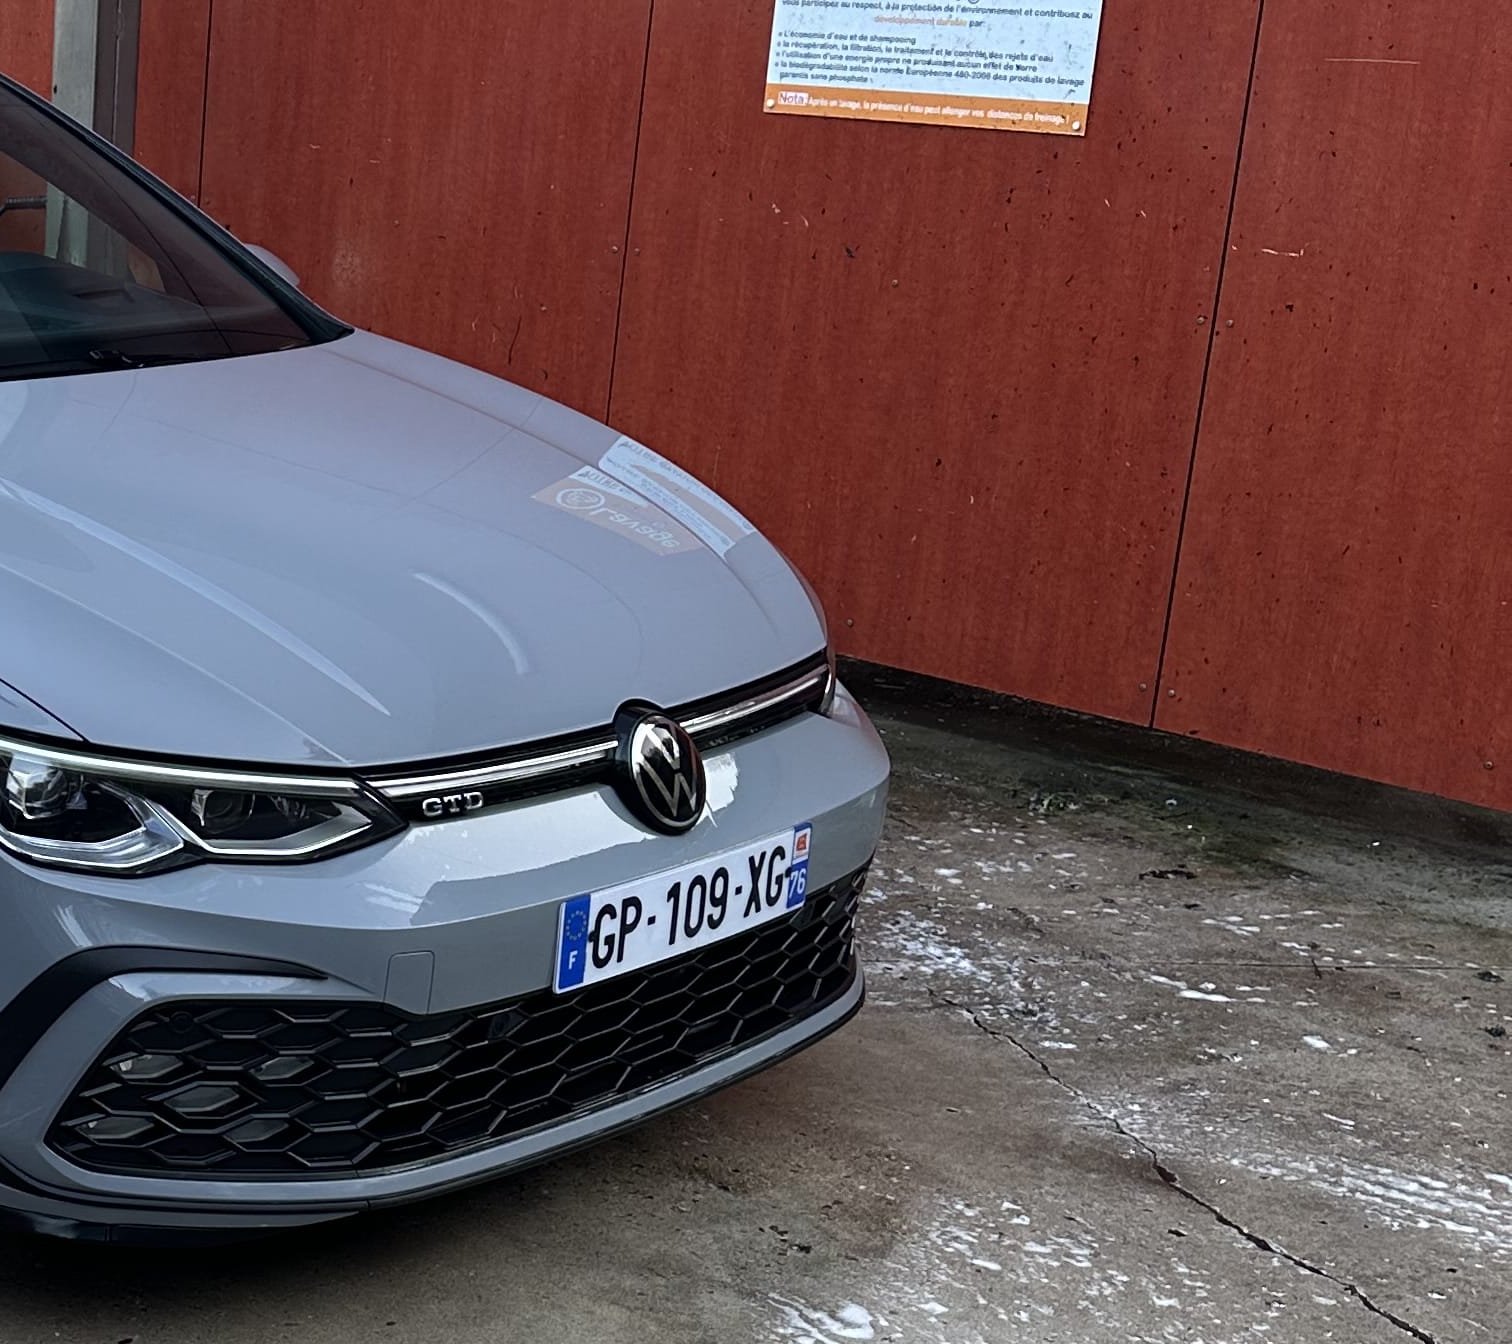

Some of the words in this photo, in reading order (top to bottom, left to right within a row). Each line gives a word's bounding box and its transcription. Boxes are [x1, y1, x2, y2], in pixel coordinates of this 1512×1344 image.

[422, 791, 484, 816] GTD
[568, 950, 578, 970] F
[590, 845, 786, 968] GP-109-XG
[788, 867, 806, 898] 76
